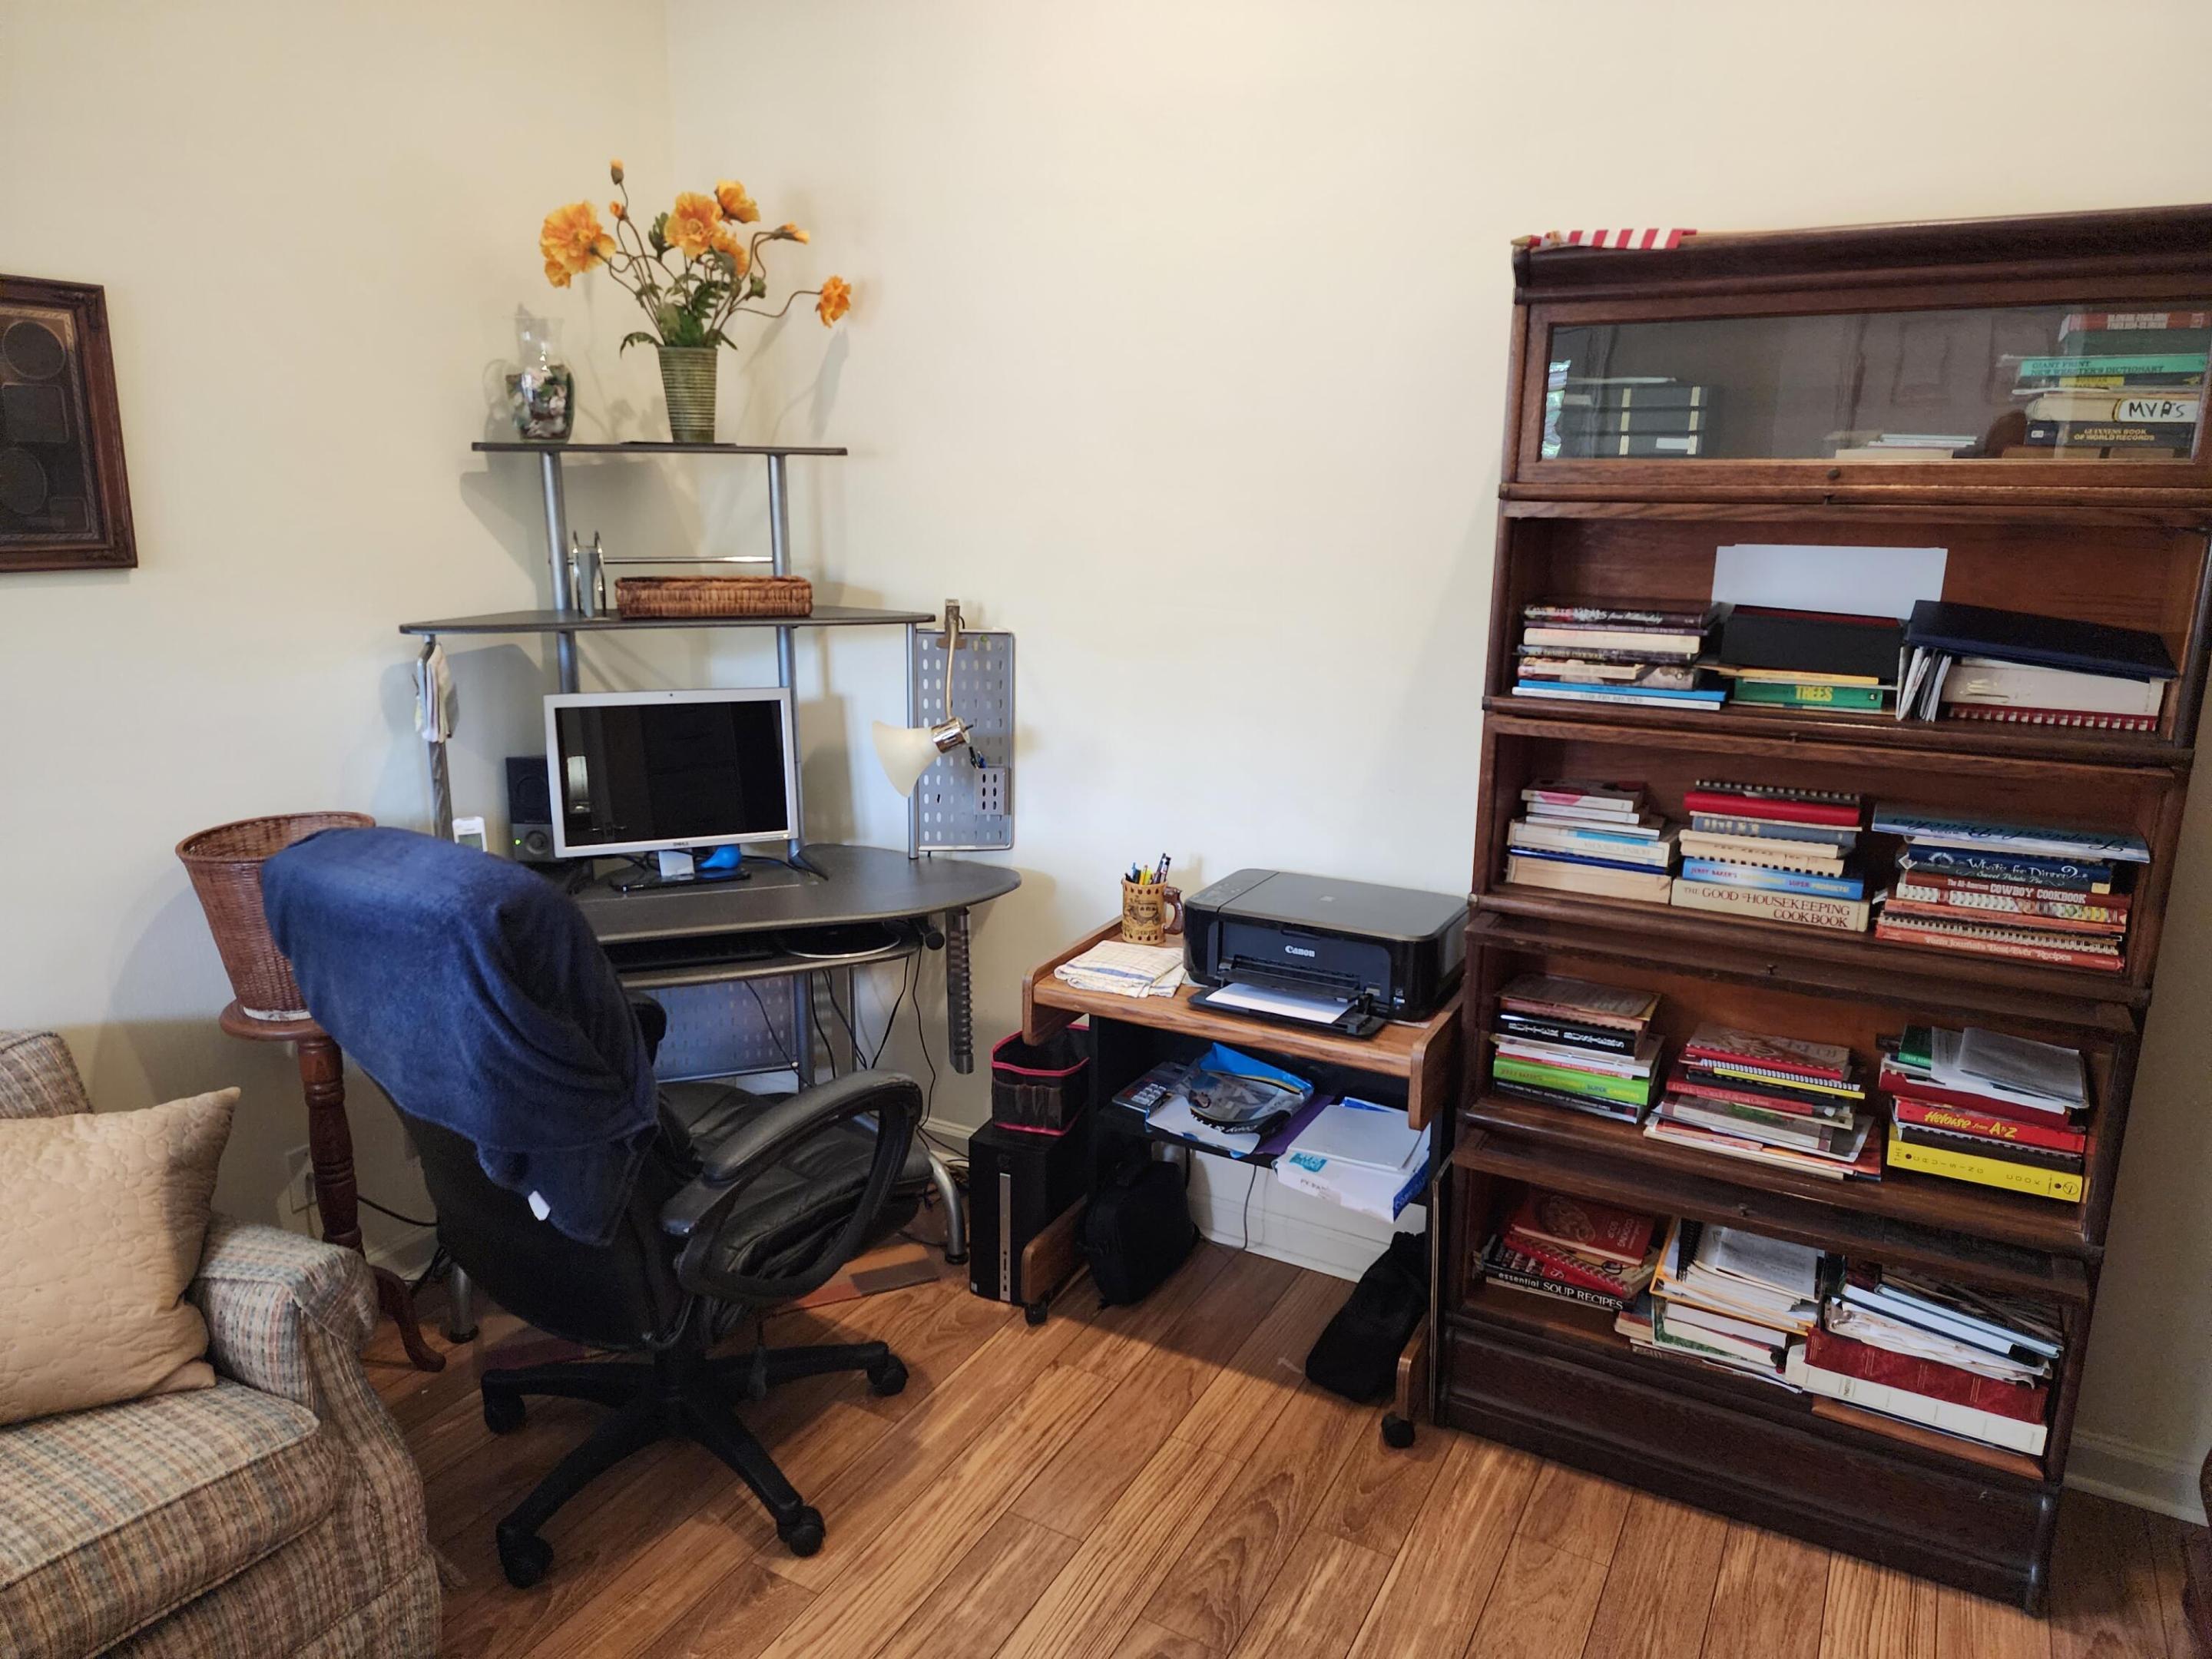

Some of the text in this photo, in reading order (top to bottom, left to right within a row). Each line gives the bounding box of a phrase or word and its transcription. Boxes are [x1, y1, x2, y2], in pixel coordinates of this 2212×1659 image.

[2032, 359, 2091, 369] GIANT PRINT
[2053, 366, 2104, 376] WEBSTER'S
[2105, 365, 2164, 374] DICTIONARY
[1794, 685, 1833, 701] TREES
[1966, 858, 2008, 871] What's
[2012, 864, 2027, 875] for
[1684, 886, 1850, 916] THE GOOD HOUSEKEEPING
[1989, 883, 2035, 898] COWBOY
[2036, 887, 2087, 904] COOKBOOK
[1773, 908, 1849, 929] COOKBOOK
[1284, 945, 1316, 959] Canon
[2035, 949, 2072, 962] Recipes
[1508, 1022, 1625, 1048] BUTTER BUSTERS
[1924, 1111, 1972, 1128] Heloise
[1988, 1121, 2001, 1135] A
[2004, 1127, 2018, 1139] Z
[1893, 1146, 1903, 1162] THE
[1912, 1155, 2041, 1186] CRUISING COOK
[1498, 1271, 1624, 1310] essential SOUP RECIPES
